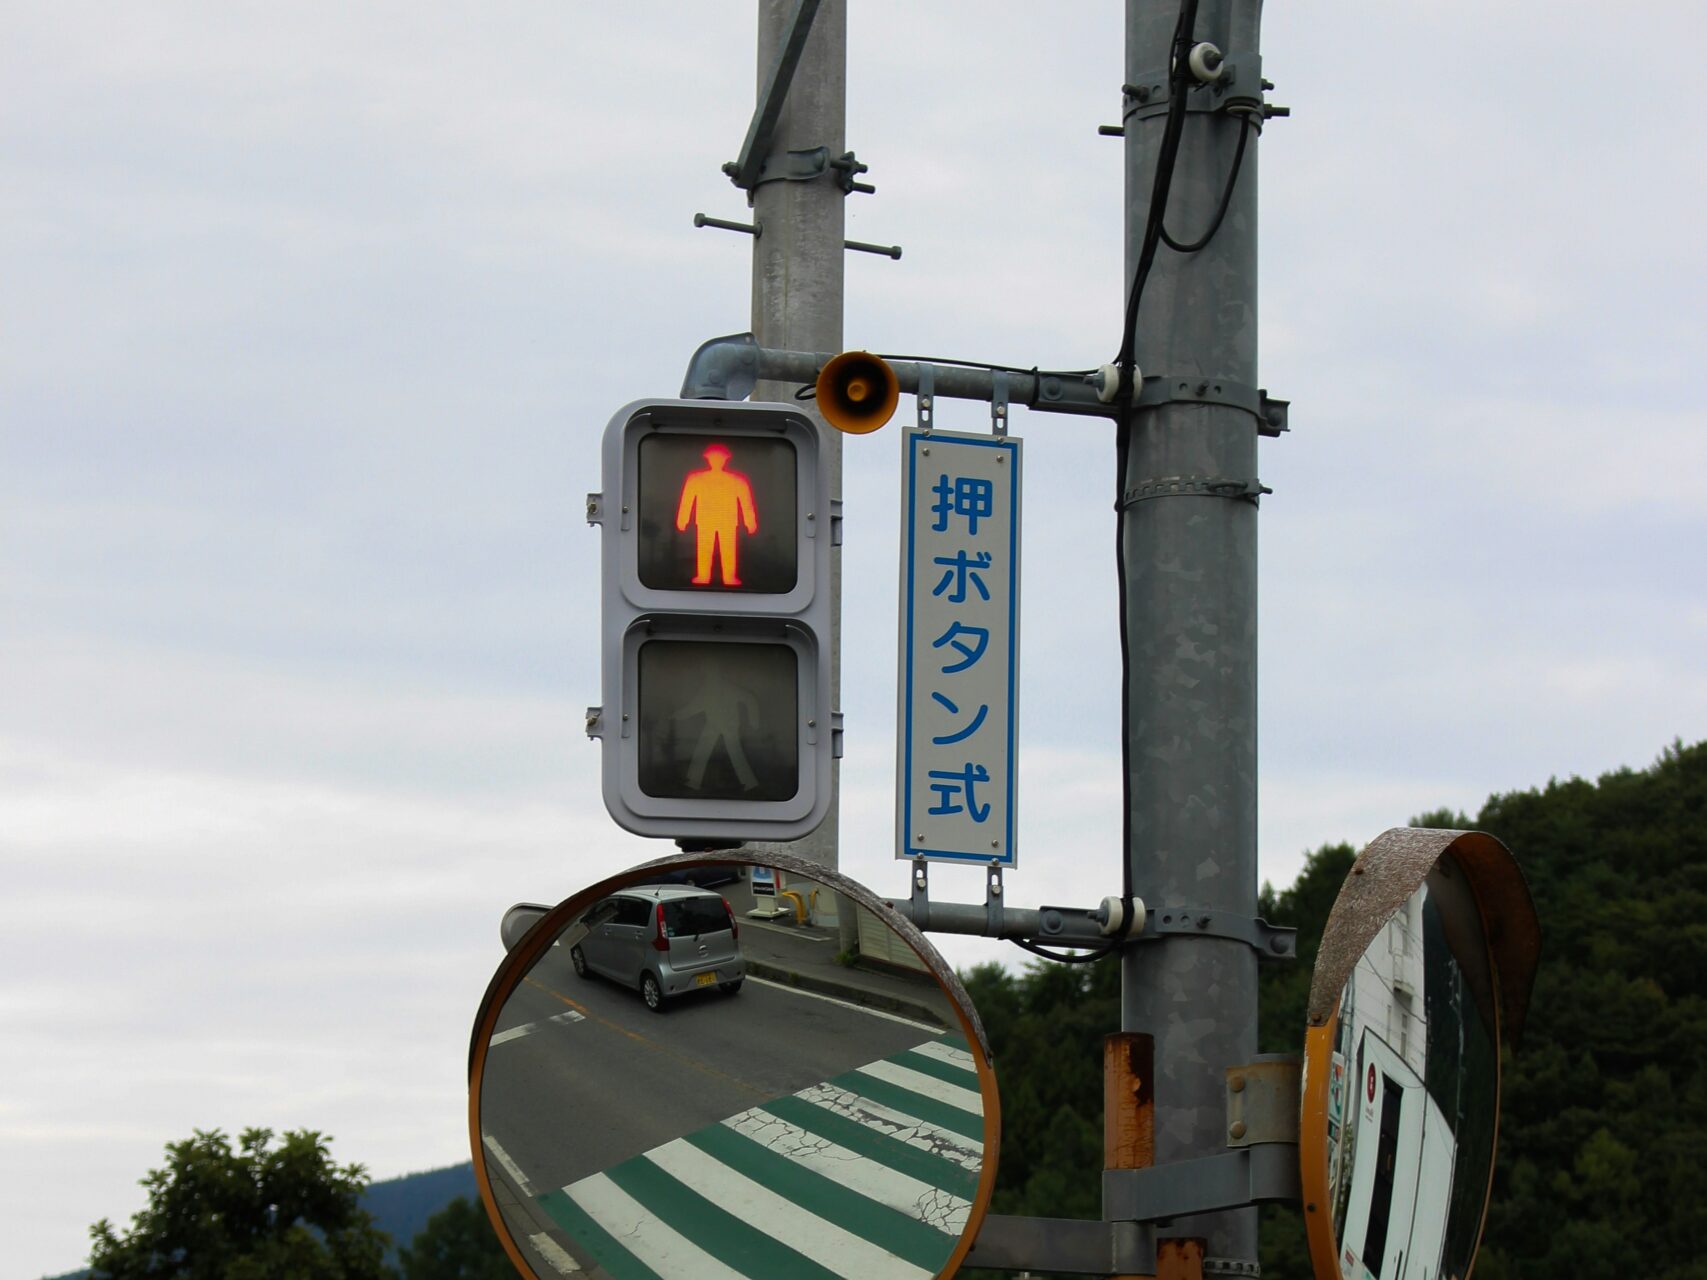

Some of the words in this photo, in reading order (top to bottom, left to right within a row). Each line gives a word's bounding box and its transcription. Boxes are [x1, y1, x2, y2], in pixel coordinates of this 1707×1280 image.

[927, 473, 994, 824] 押ボタン式
